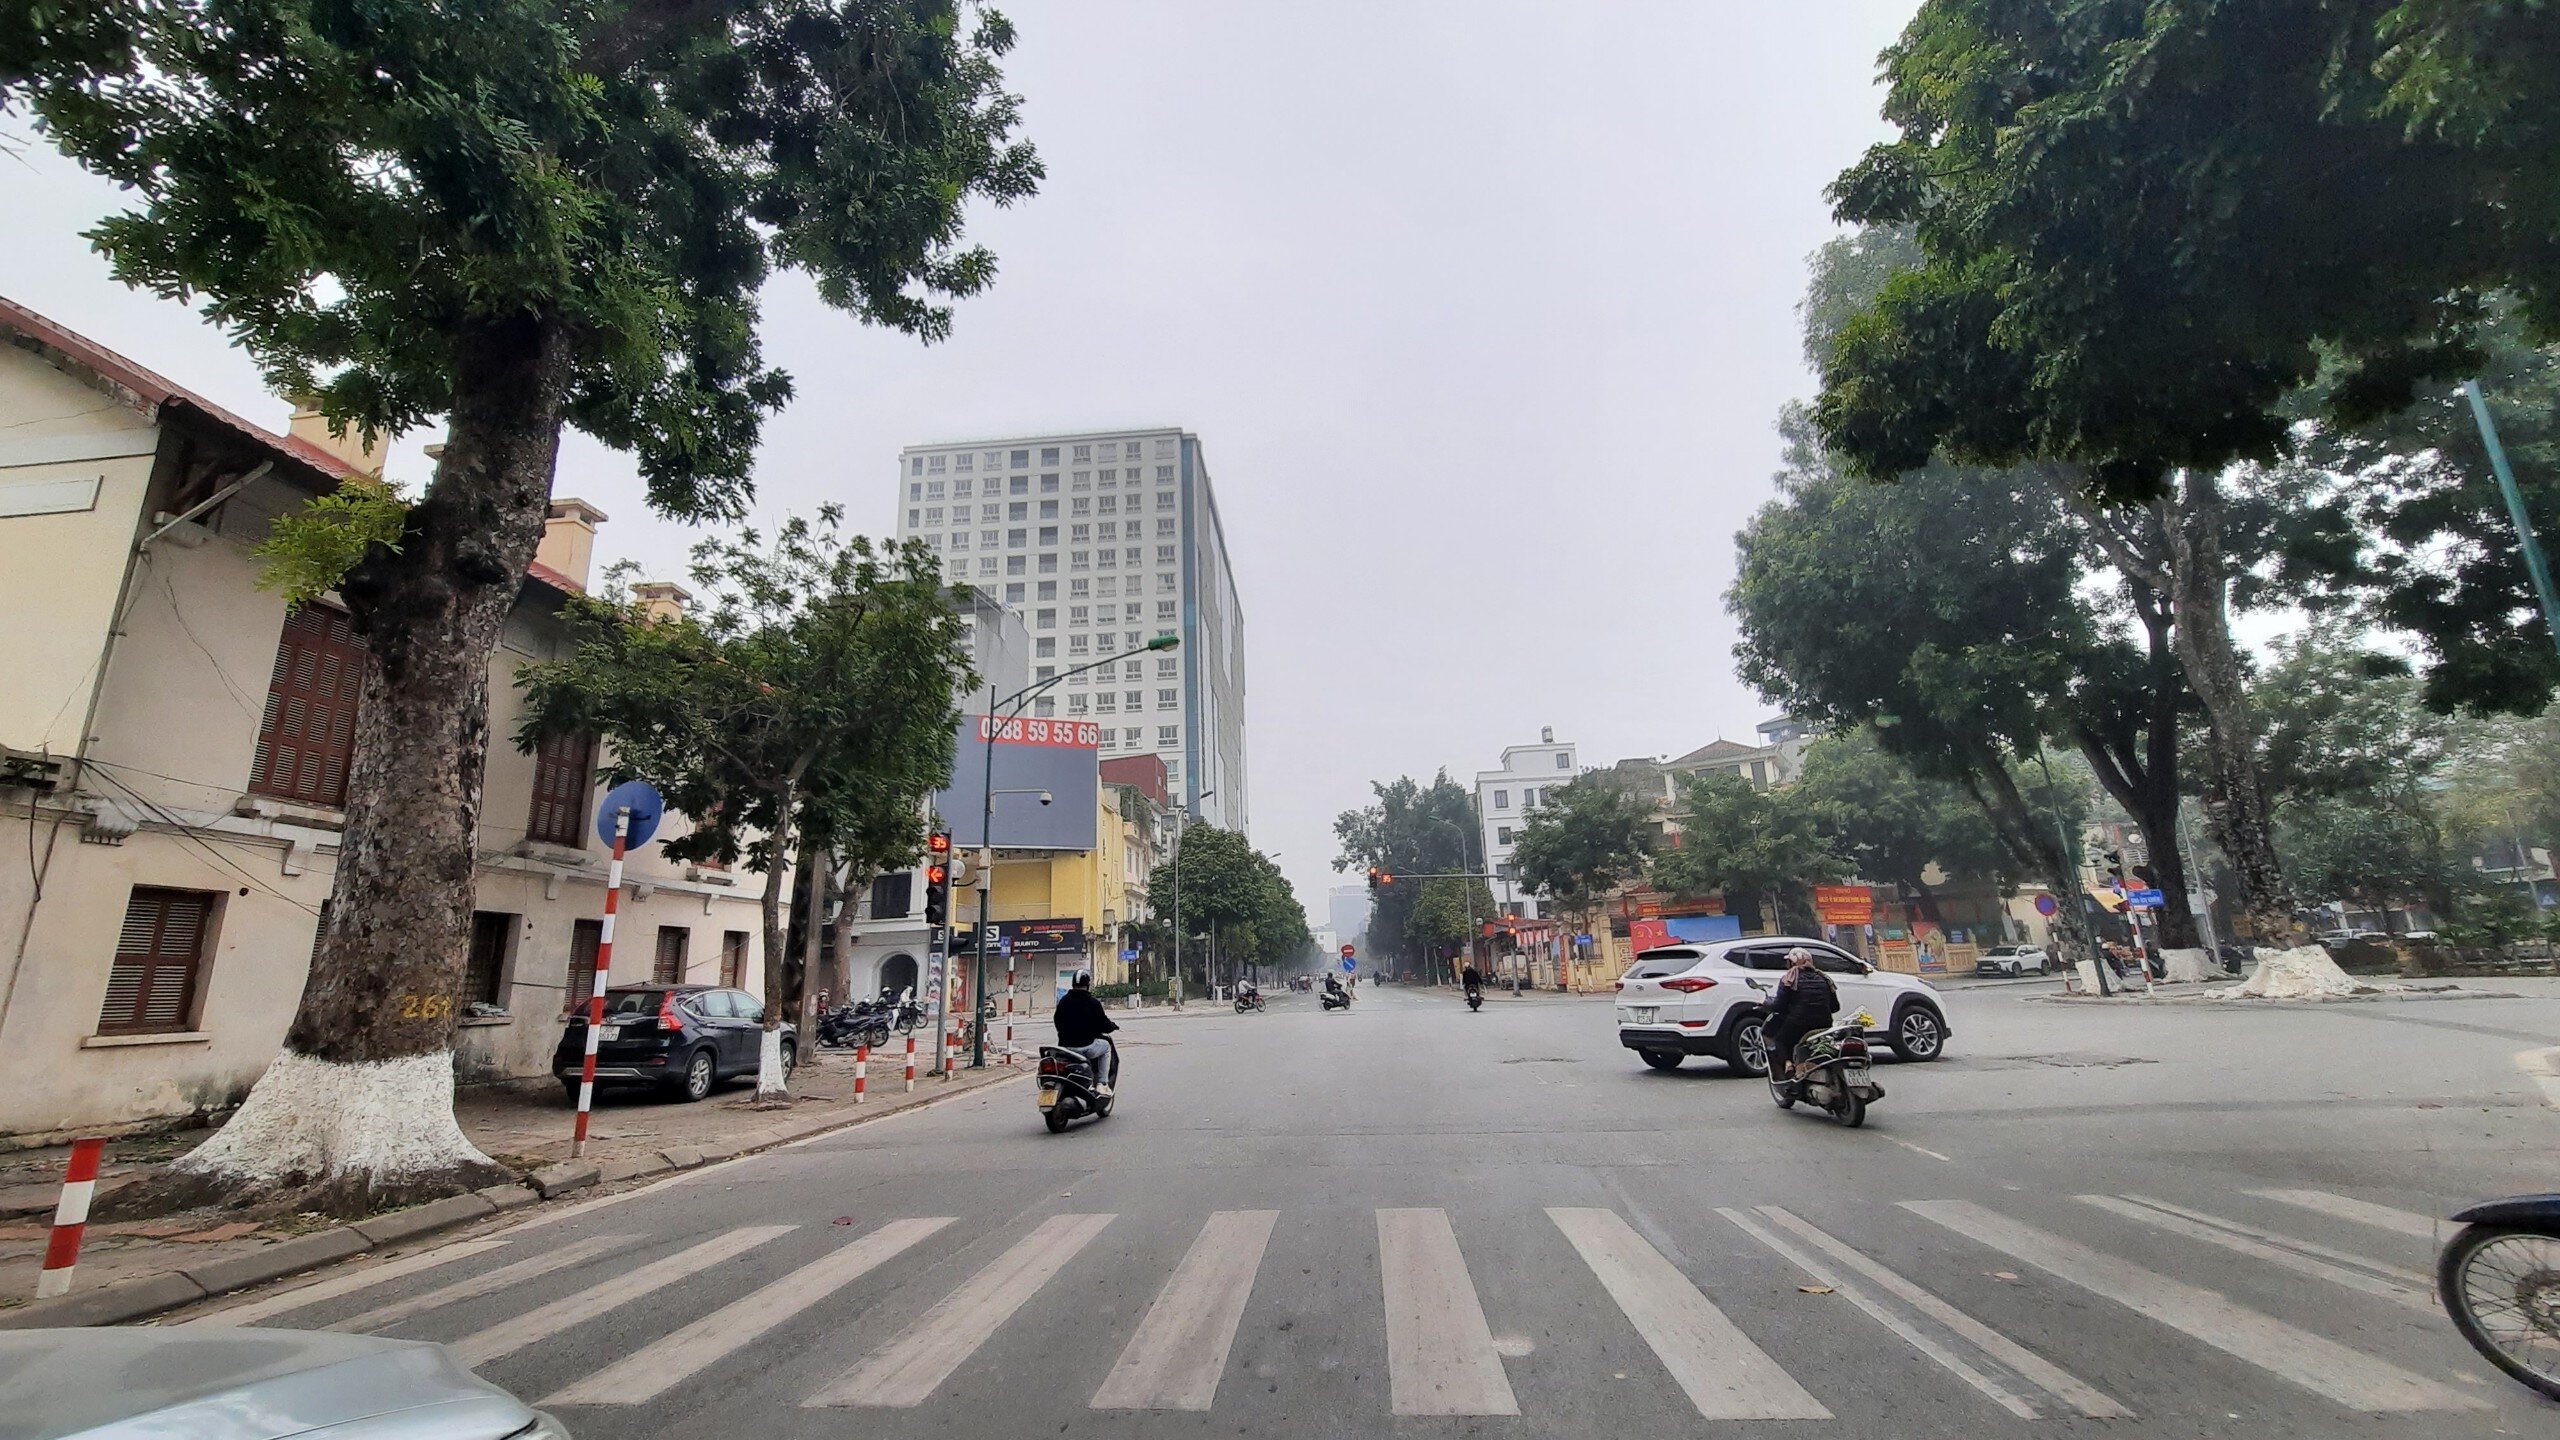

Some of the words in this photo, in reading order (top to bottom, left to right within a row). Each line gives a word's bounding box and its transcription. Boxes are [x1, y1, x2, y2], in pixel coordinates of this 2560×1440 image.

[980, 717, 1023, 740] 0988
[1027, 720, 1049, 742] 59
[1053, 722, 1073, 743] 55
[1078, 724, 1098, 745] 66
[934, 836, 946, 848] 35
